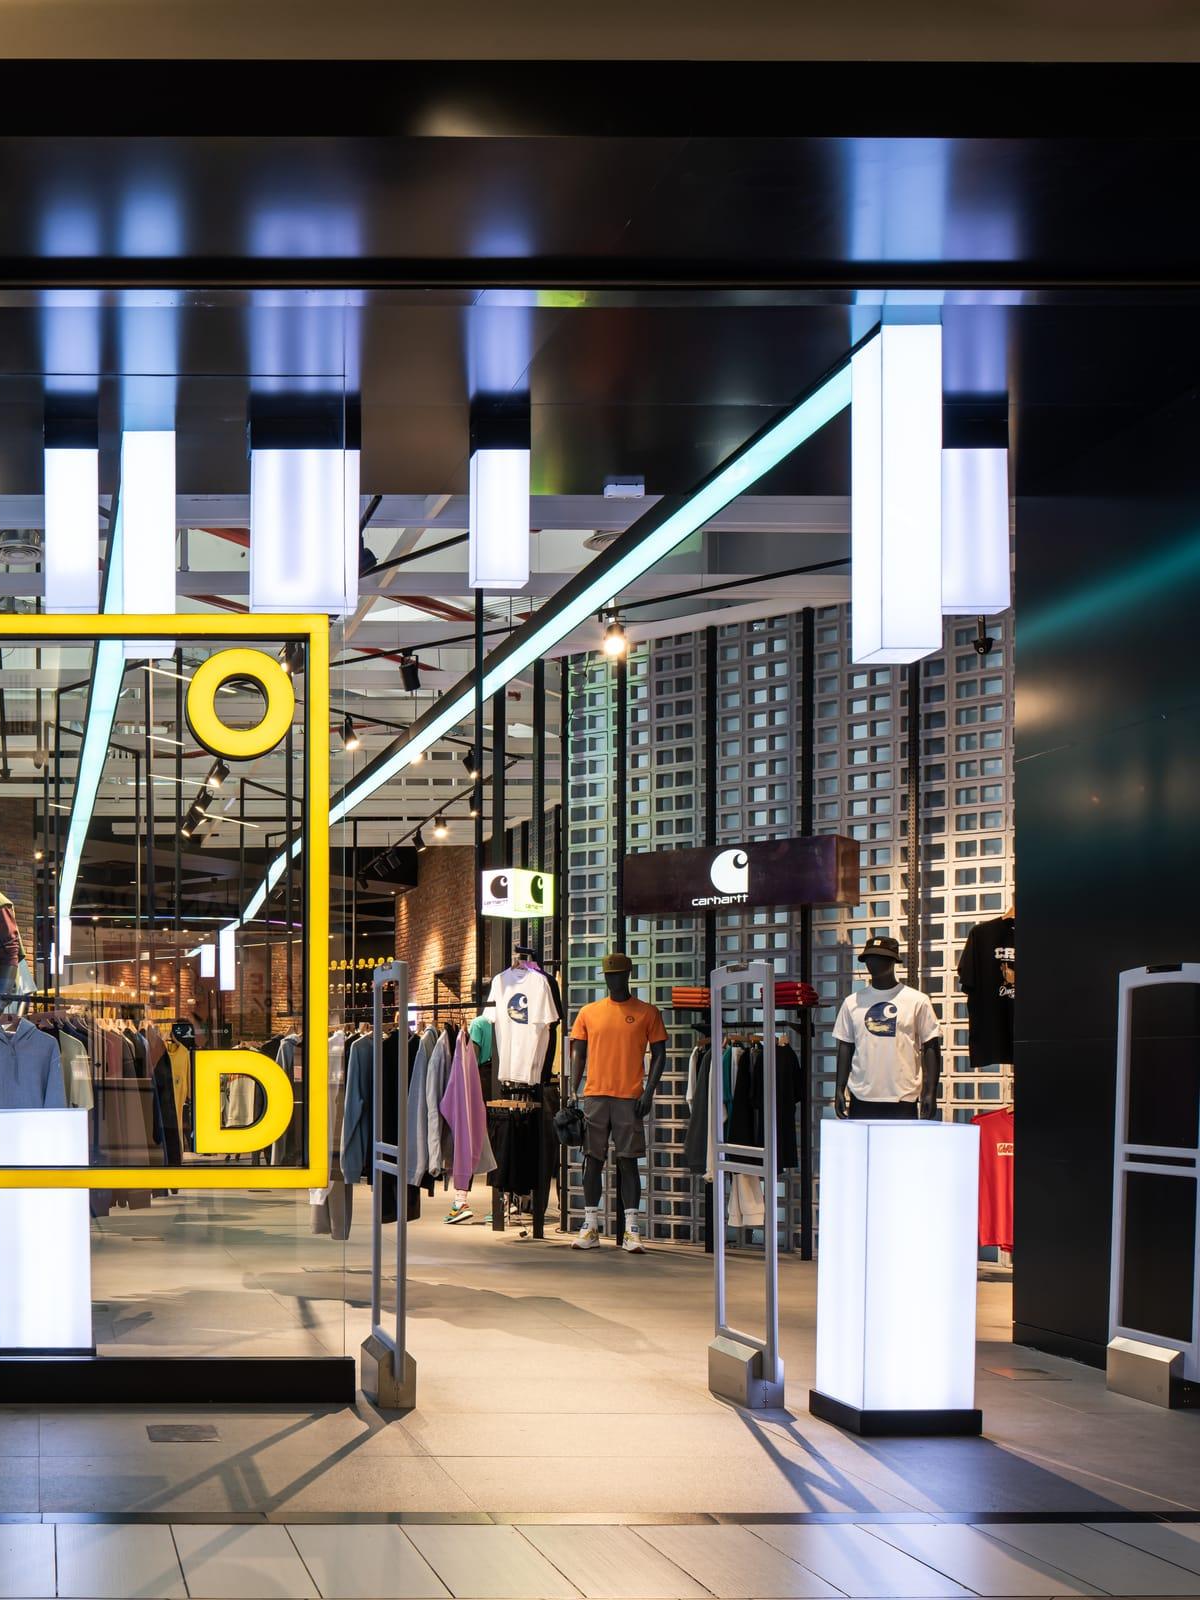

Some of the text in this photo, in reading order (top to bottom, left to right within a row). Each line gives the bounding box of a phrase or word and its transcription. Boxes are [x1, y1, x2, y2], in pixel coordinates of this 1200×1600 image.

[187, 647, 295, 759] O
[692, 894, 749, 906] carhartt
[193, 1049, 294, 1154] D
